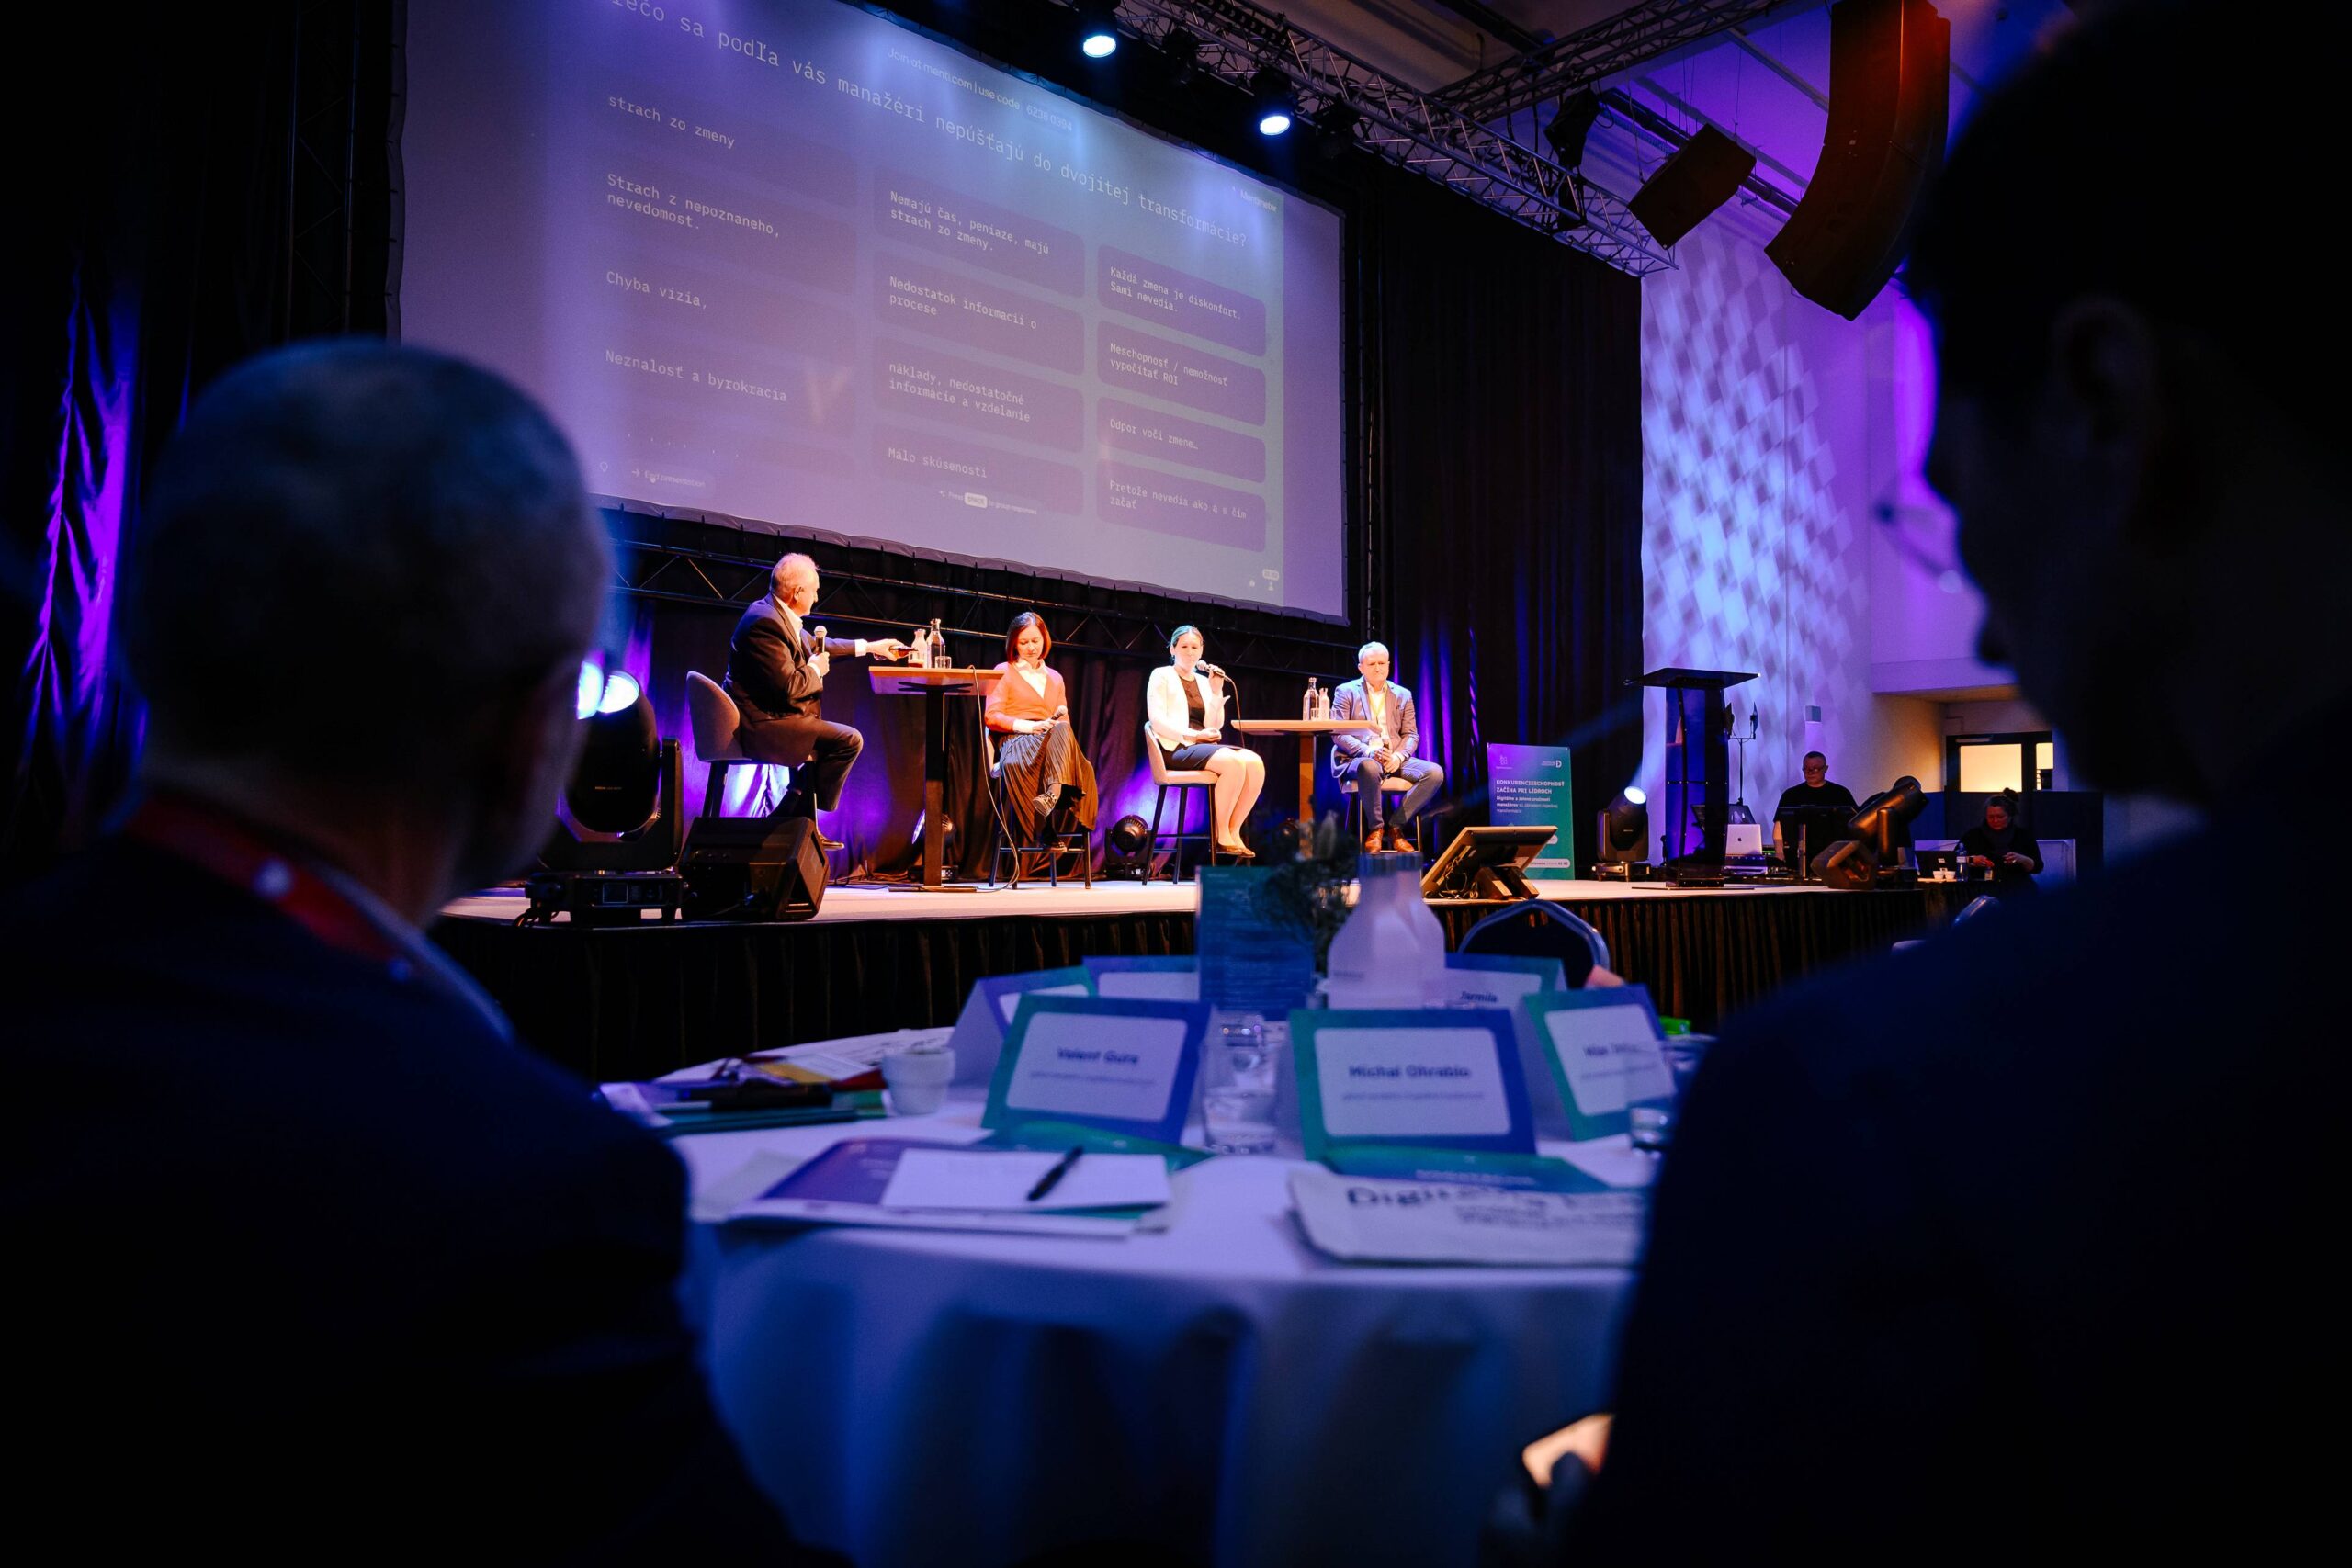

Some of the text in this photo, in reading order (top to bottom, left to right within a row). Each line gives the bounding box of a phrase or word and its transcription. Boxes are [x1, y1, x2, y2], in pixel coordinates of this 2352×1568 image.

[888, 47, 909, 63] Join
[911, 57, 922, 69] at
[924, 63, 972, 91] menti.com
[979, 87, 995, 99] use
[997, 93, 1020, 110] code
[609, 96, 735, 149] strach zo zmeny
[680, 17, 705, 38] sa
[718, 32, 779, 66] podľa
[793, 61, 826, 84] vás
[838, 78, 925, 123] manažéri
[936, 117, 1023, 161] nepúšťajú
[1034, 153, 1051, 171] do
[1061, 164, 1129, 205] dvojitej
[1138, 193, 1247, 246] transformácie?
[607, 173, 779, 238] Strach z nepoznaneho,
[890, 190, 1049, 254] Nemajú čas, peniaze, majú
[890, 209, 994, 251] strach zo zmeny.
[606, 270, 650, 293] Chyba
[1110, 266, 1137, 285] Každá
[1143, 280, 1169, 295] zmena
[1173, 288, 1184, 301] je
[1110, 281, 1178, 312] Sami nevedia.
[889, 293, 937, 316] procese
[890, 275, 956, 305] Nedostatok
[1030, 320, 1037, 330] o
[605, 349, 786, 402] Neznalosť a byrokracia
[949, 378, 1024, 405] nedostatočné
[1163, 372, 1179, 386] ROI
[975, 400, 1030, 423] vzdelanie
[1110, 418, 1137, 434] Odpor
[1142, 428, 1163, 441] voči
[888, 447, 916, 463] Málo
[1110, 479, 1148, 498] Pretože
